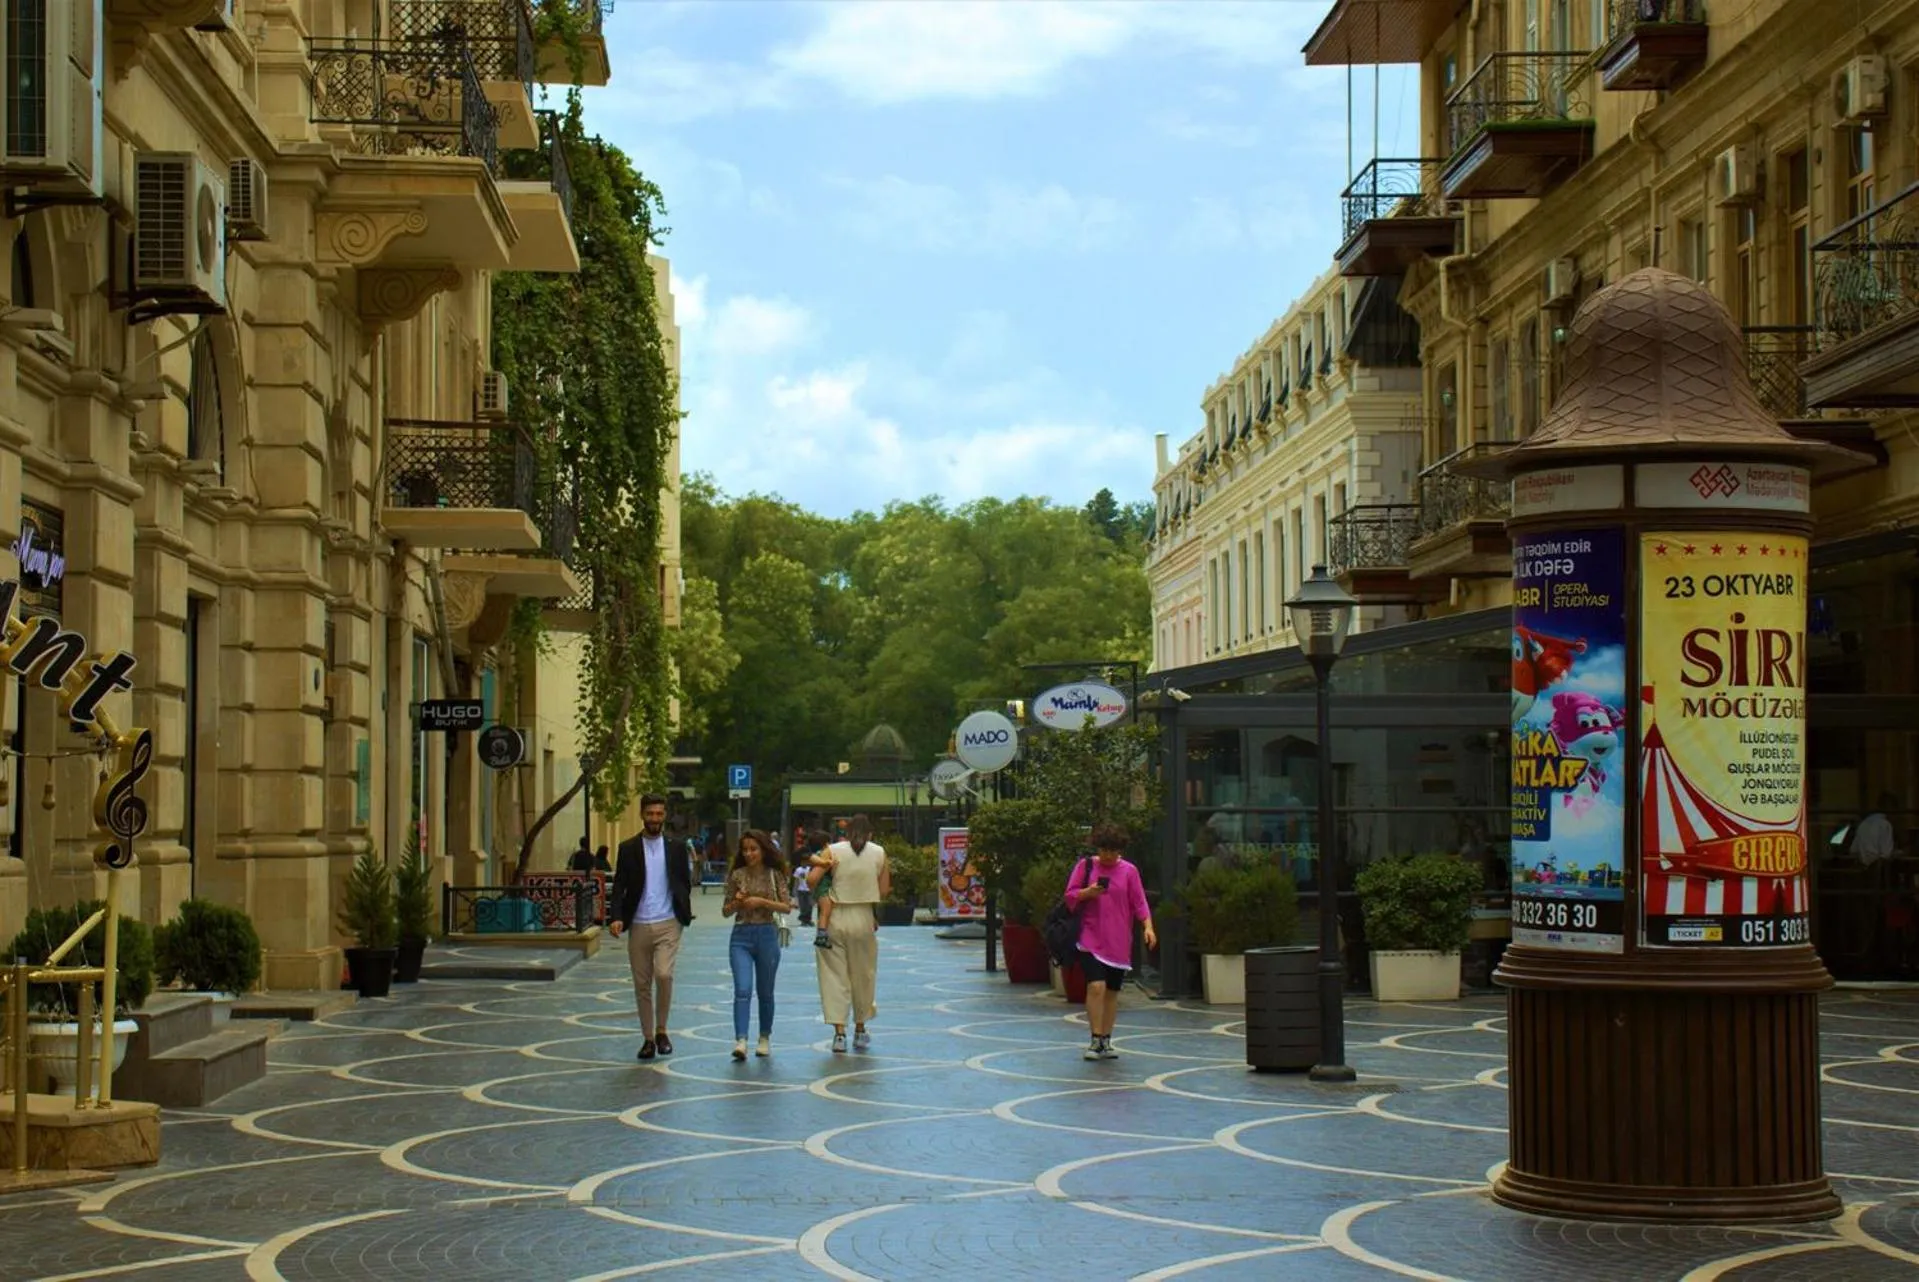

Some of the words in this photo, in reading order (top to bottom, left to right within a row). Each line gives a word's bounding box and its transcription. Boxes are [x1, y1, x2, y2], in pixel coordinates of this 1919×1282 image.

[1525, 541, 1561, 557] TƏQDİM
[1563, 538, 1592, 553] EDİR
[1534, 558, 1575, 576] DƏFƏ
[1552, 583, 1589, 595] OPERA
[1665, 576, 1696, 598] 23
[1702, 574, 1794, 597] OKTYABR
[1552, 593, 1610, 608] STUDİYASI
[422, 705, 482, 718] HUGO
[964, 729, 1009, 746] MADO
[1752, 748, 1780, 759] PUDEL
[734, 768, 748, 785] P
[1727, 763, 1771, 776] QUŞLAR
[1740, 793, 1758, 804] VƏ
[1521, 900, 1543, 925] 332
[1546, 903, 1568, 927] 36
[1572, 904, 1598, 928] 30
[1741, 919, 1775, 943] 051
